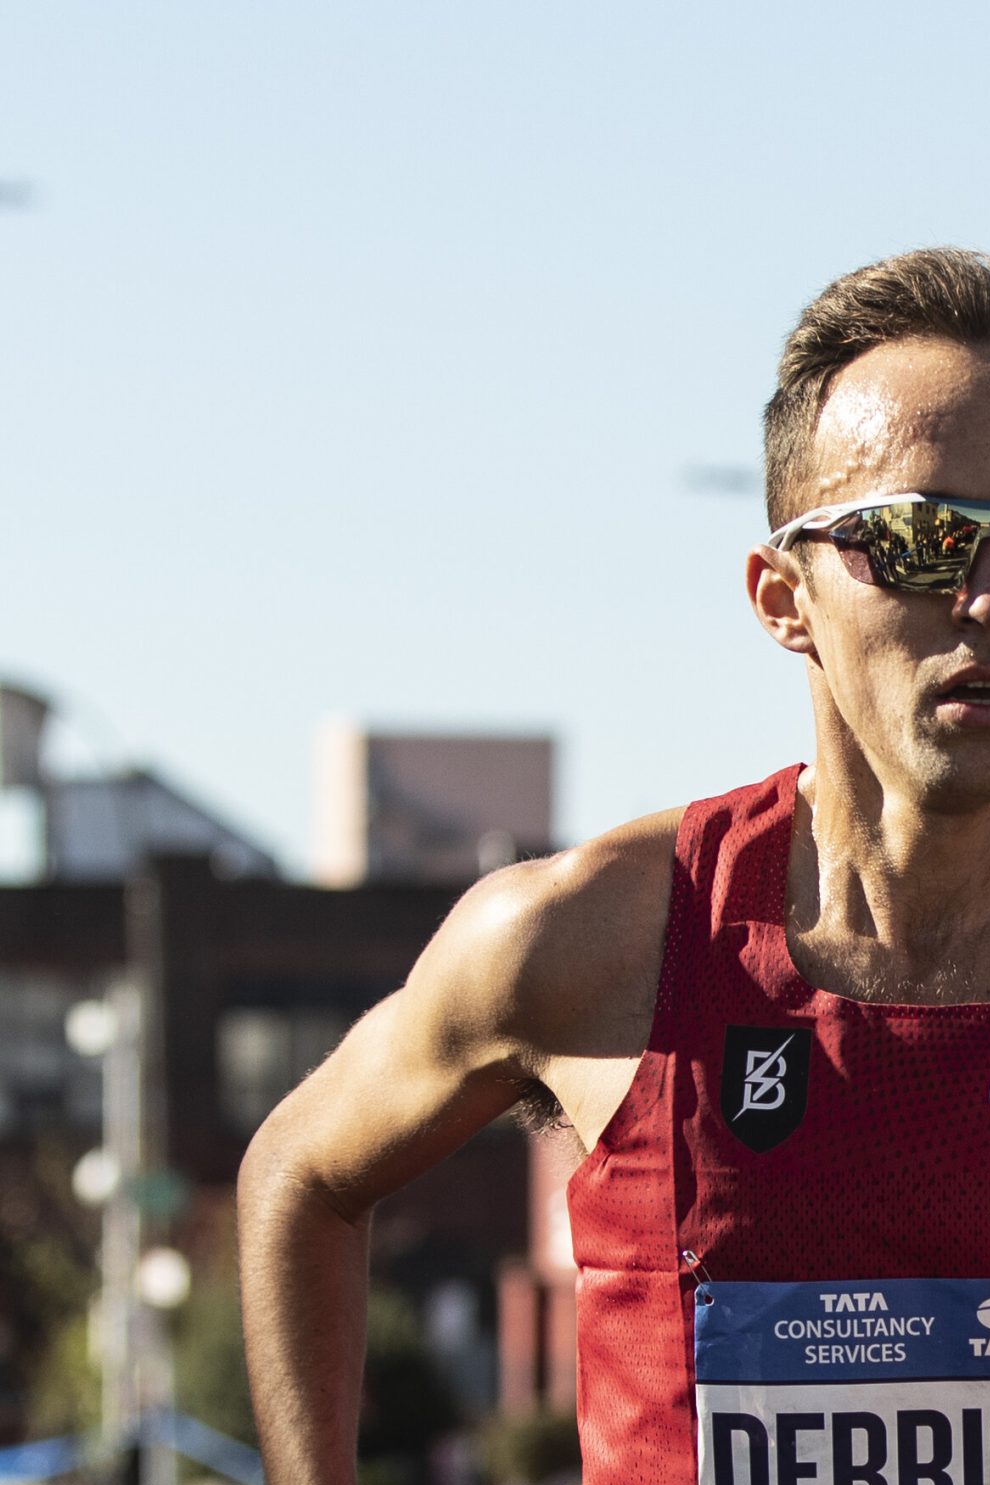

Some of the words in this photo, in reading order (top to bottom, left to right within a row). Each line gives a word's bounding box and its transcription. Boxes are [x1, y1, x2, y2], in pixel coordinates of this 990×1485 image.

[820, 1292, 888, 1312] TATA
[774, 1317, 935, 1339] CONSULTANCY
[805, 1343, 907, 1364] SERVICES
